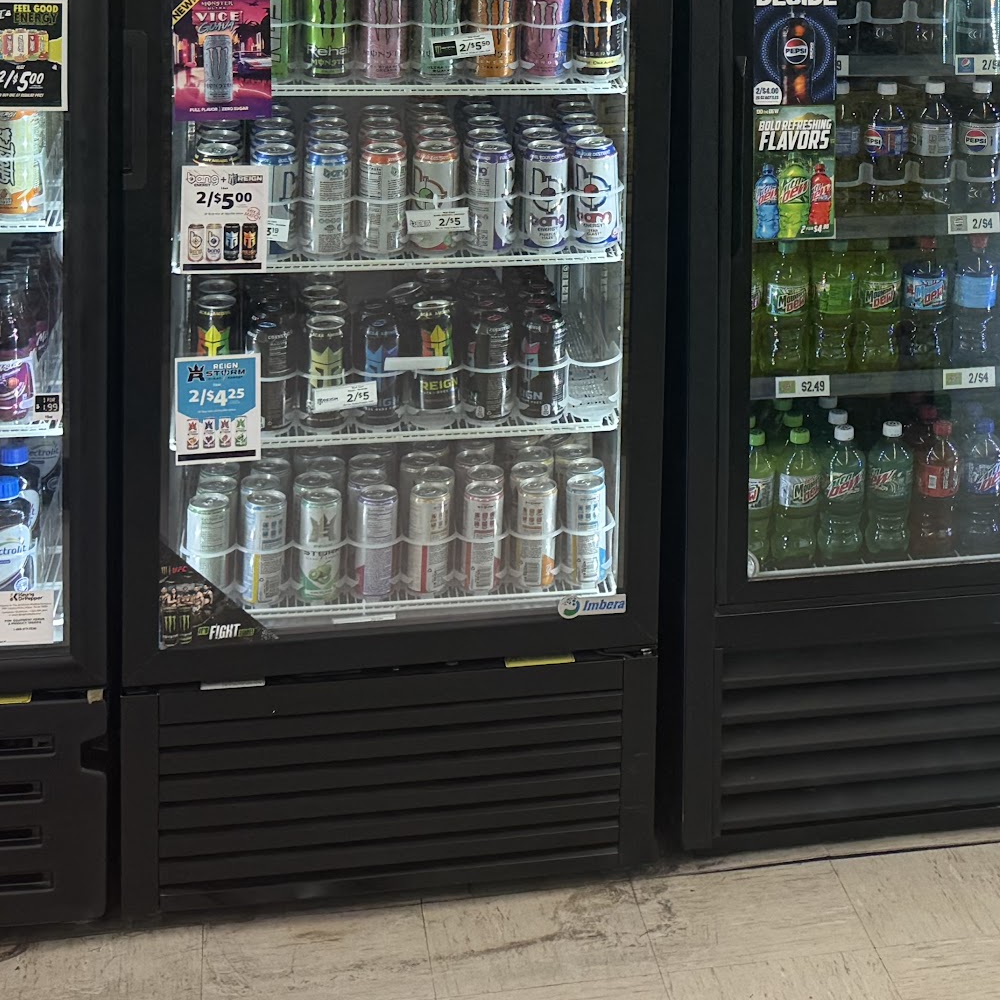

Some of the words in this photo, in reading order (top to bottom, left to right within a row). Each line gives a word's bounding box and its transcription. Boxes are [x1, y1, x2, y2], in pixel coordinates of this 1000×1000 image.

[13, 4, 31, 12] FEEL
[33, 4, 59, 13] GOOD
[13, 13, 57, 23] ENERGY
[196, 11, 240, 21] VICE
[198, 20, 235, 34] GUAVA
[758, 120, 780, 131] BOLD
[781, 119, 832, 130] REFRESHING
[758, 130, 830, 151] FLAVORS
[187, 171, 219, 186] bang
[438, 217, 461, 227] 2/$5
[531, 214, 565, 228] bang
[577, 211, 612, 225] bang
[972, 219, 993, 229] 2/$4
[213, 362, 239, 370] REIGN
[206, 369, 246, 377] STORM
[968, 372, 989, 383] 2/$4
[422, 377, 459, 391] REIGN
[801, 381, 825, 392] $2.49
[347, 391, 370, 403] 2/$5
[29, 446, 59, 456] ectrolit
[583, 600, 625, 612] Imbera
[209, 623, 242, 641] FIGHT
